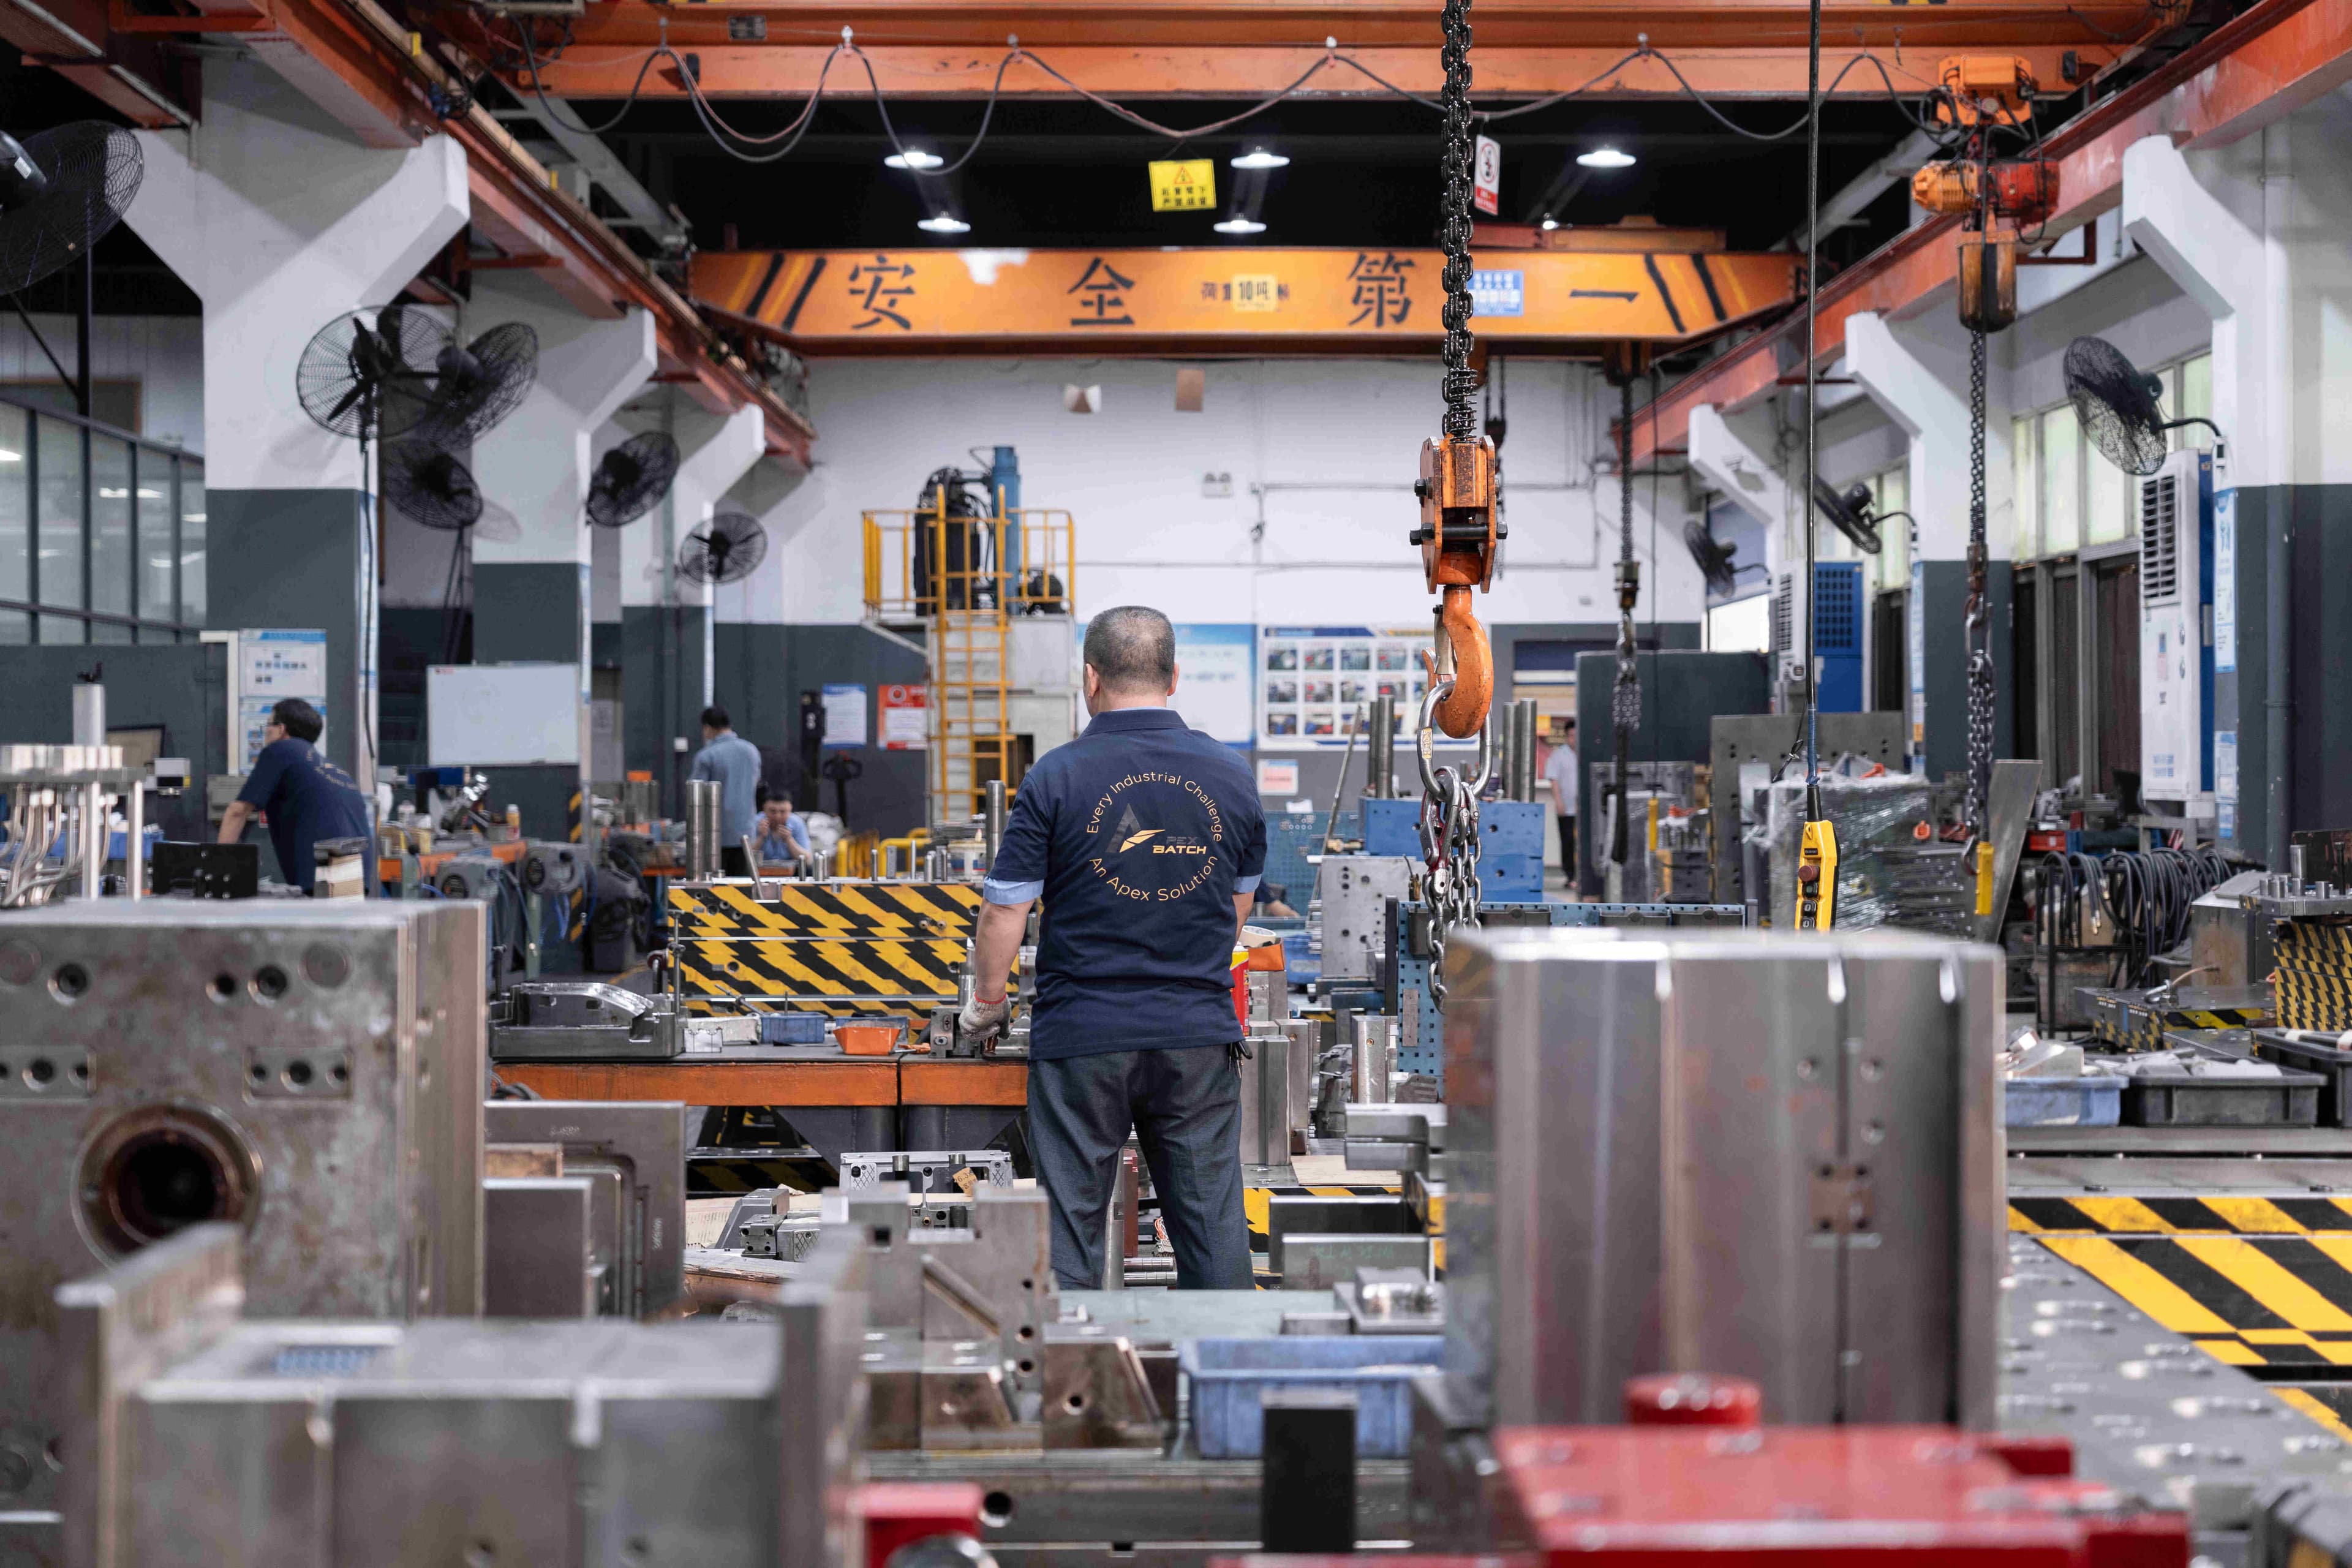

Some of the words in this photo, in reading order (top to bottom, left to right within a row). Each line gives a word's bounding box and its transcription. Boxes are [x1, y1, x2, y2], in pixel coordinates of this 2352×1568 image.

[1087, 793, 1112, 834] Every
[1110, 771, 1182, 794] Industrial
[1185, 780, 1223, 842] Challenge
[1152, 845, 1207, 854] BATCH
[1089, 858, 1107, 877] An
[1106, 876, 1150, 901] Apex
[1158, 856, 1218, 902] Solution
[957, 1172, 970, 1182] 6.3
